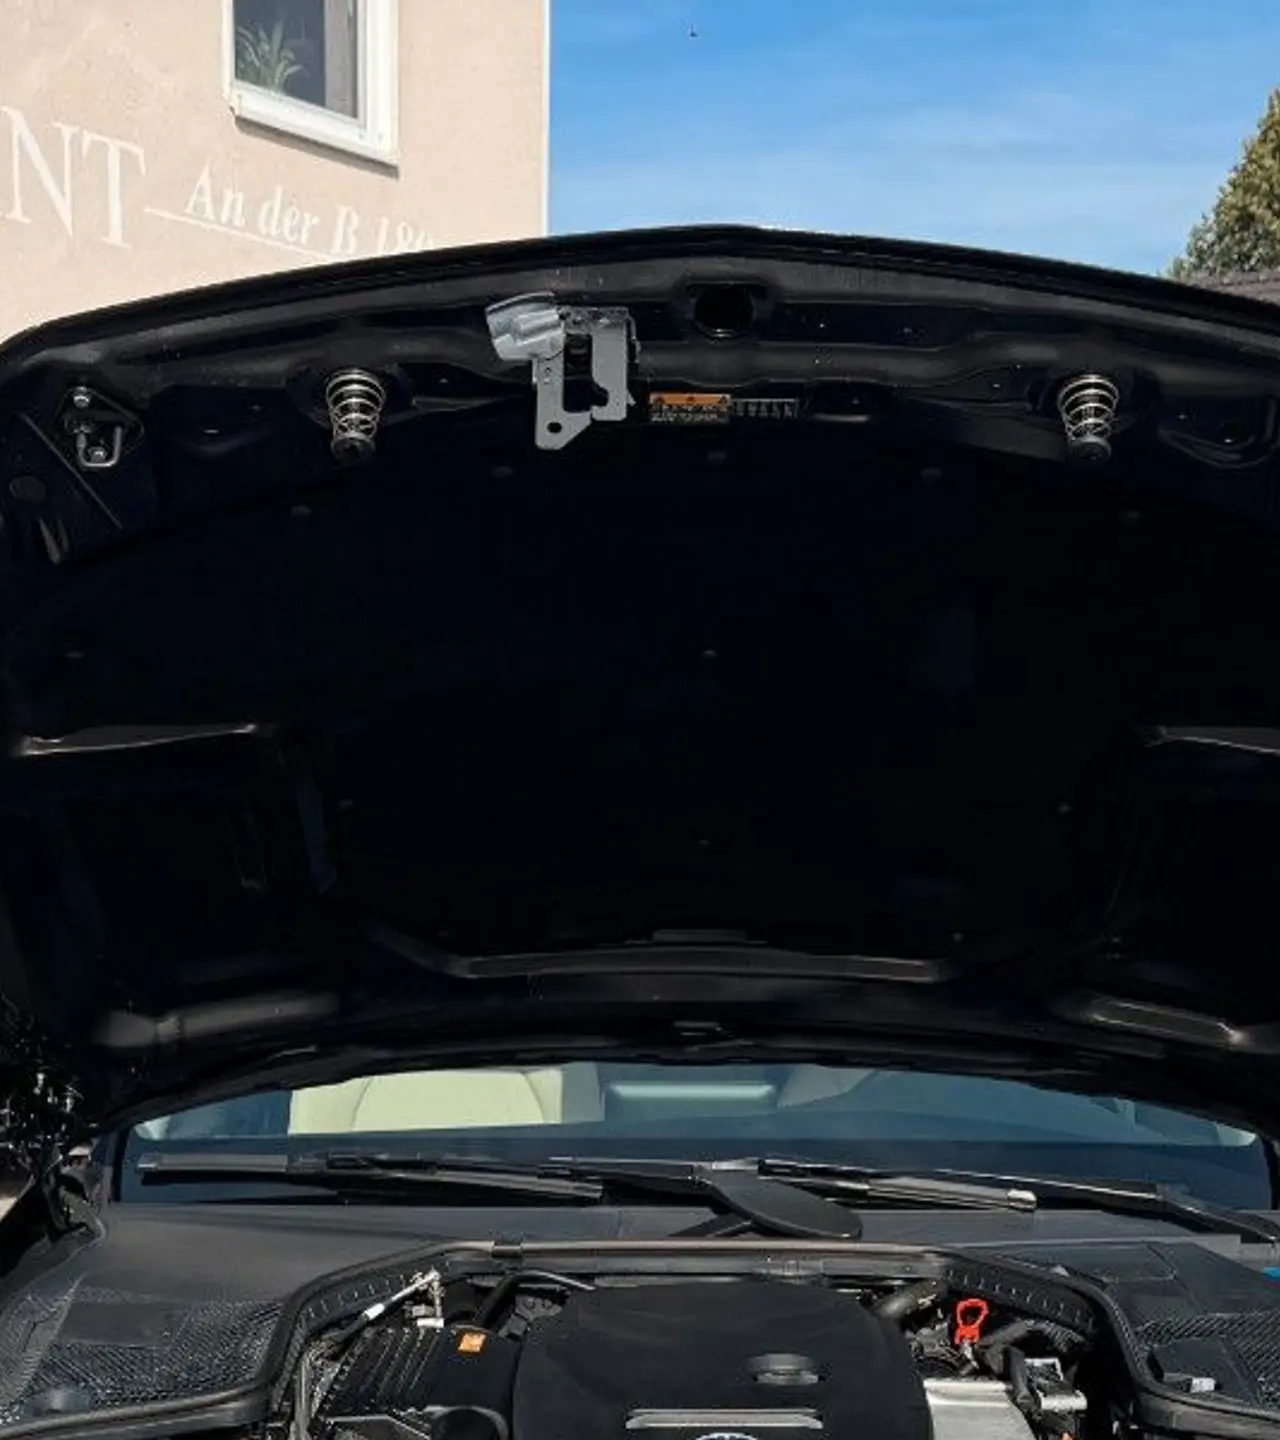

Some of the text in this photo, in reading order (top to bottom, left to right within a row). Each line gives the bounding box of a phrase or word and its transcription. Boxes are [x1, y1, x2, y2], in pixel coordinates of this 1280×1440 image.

[184, 164, 246, 228] An
[258, 185, 320, 244] der
[330, 203, 360, 255] B
